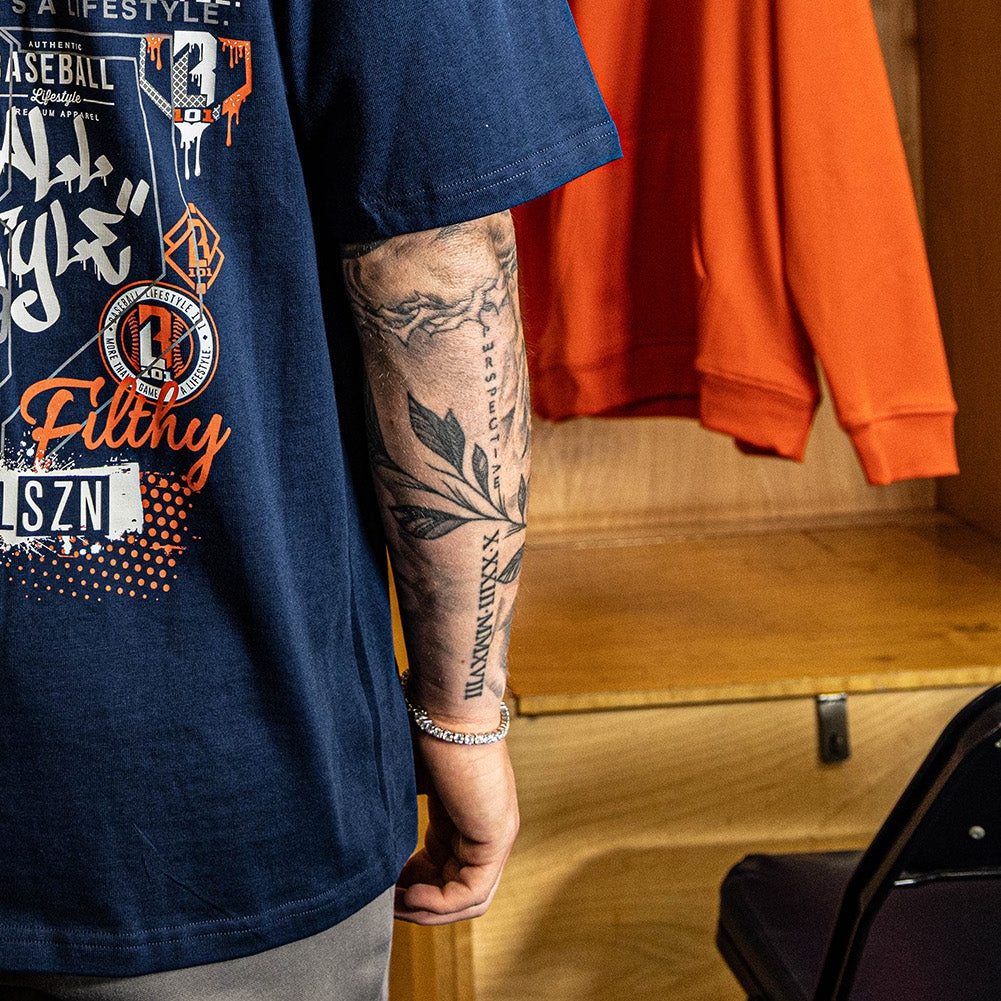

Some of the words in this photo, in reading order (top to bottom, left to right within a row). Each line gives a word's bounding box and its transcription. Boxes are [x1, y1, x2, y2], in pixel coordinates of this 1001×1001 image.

[28, 40, 83, 51] AUTHENTIC
[30, 87, 82, 107] Lifestyle
[173, 108, 214, 123] 101
[145, 287, 194, 314] LIFESTYLE
[105, 337, 120, 361] MORE
[138, 383, 158, 397] GAME
[20, 376, 232, 492] Filthy
